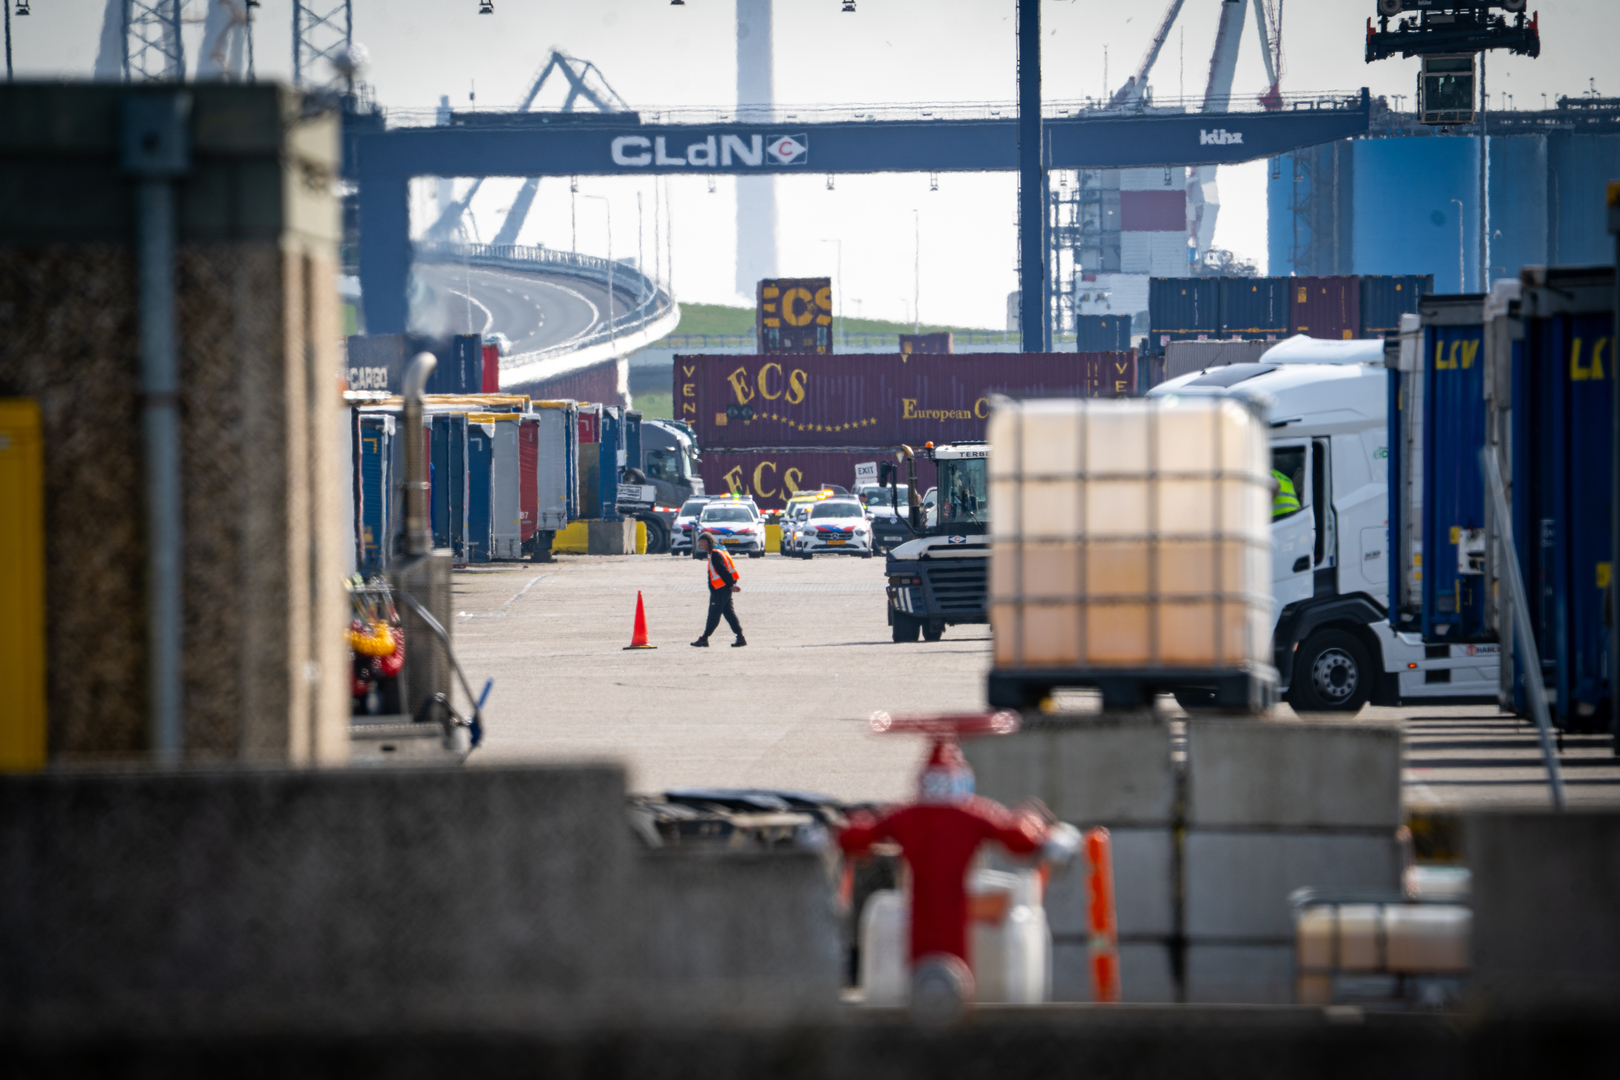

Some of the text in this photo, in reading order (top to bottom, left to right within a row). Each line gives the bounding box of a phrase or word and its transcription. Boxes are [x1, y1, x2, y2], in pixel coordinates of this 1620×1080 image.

[611, 134, 763, 167] CLdN
[1570, 337, 1615, 381] LK
[727, 362, 807, 405] ECS
[1115, 362, 1128, 393] VE
[902, 397, 991, 423] European C
[722, 461, 803, 501] ECS
[858, 466, 874, 475] EXIT
